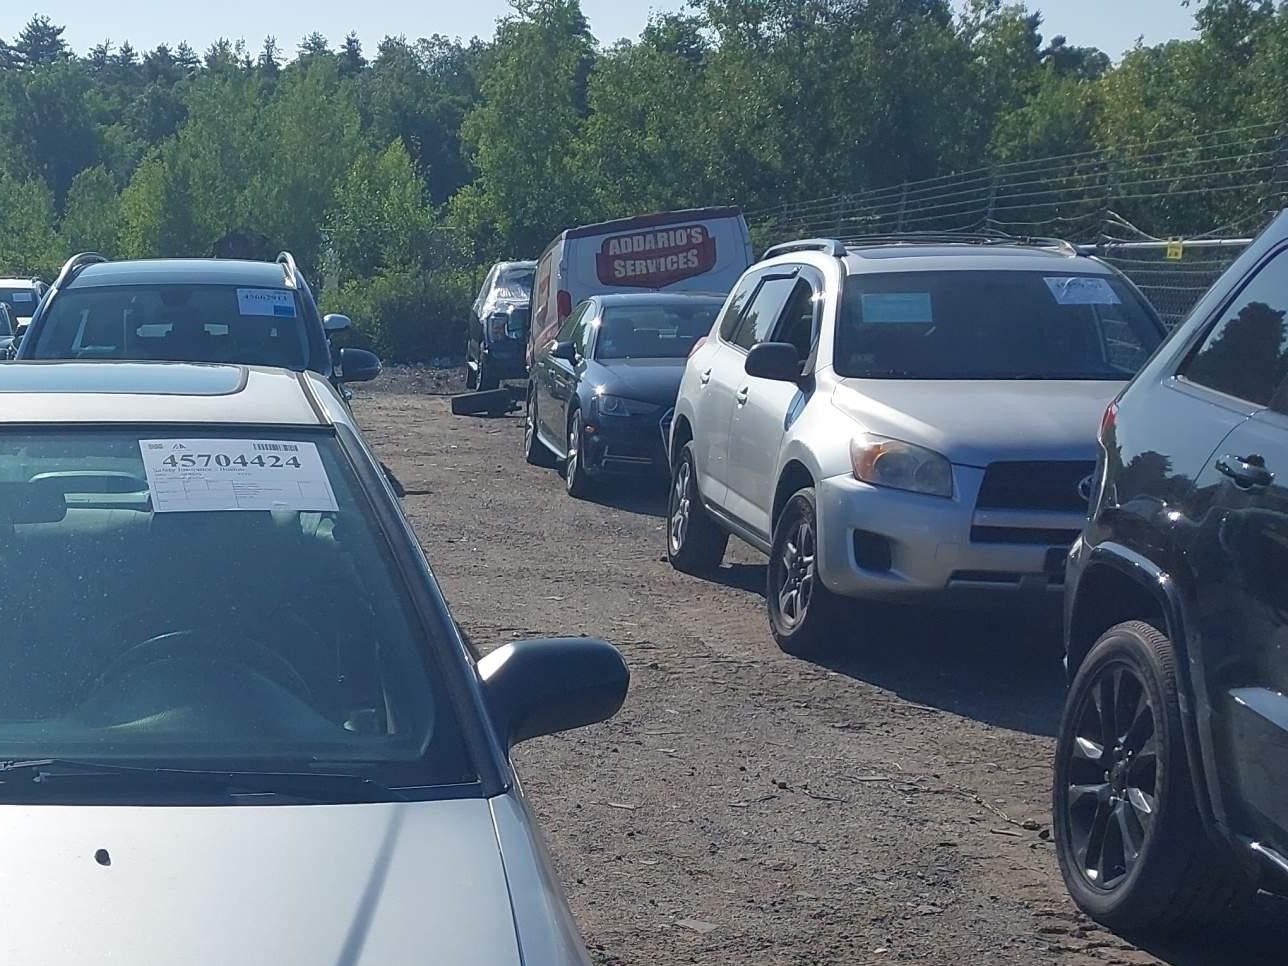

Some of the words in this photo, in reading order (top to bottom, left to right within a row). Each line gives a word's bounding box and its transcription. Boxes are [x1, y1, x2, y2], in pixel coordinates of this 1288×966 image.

[609, 227, 703, 255] ADDARIO'S
[614, 249, 698, 277] SERVICES
[162, 453, 302, 468] 45704424
